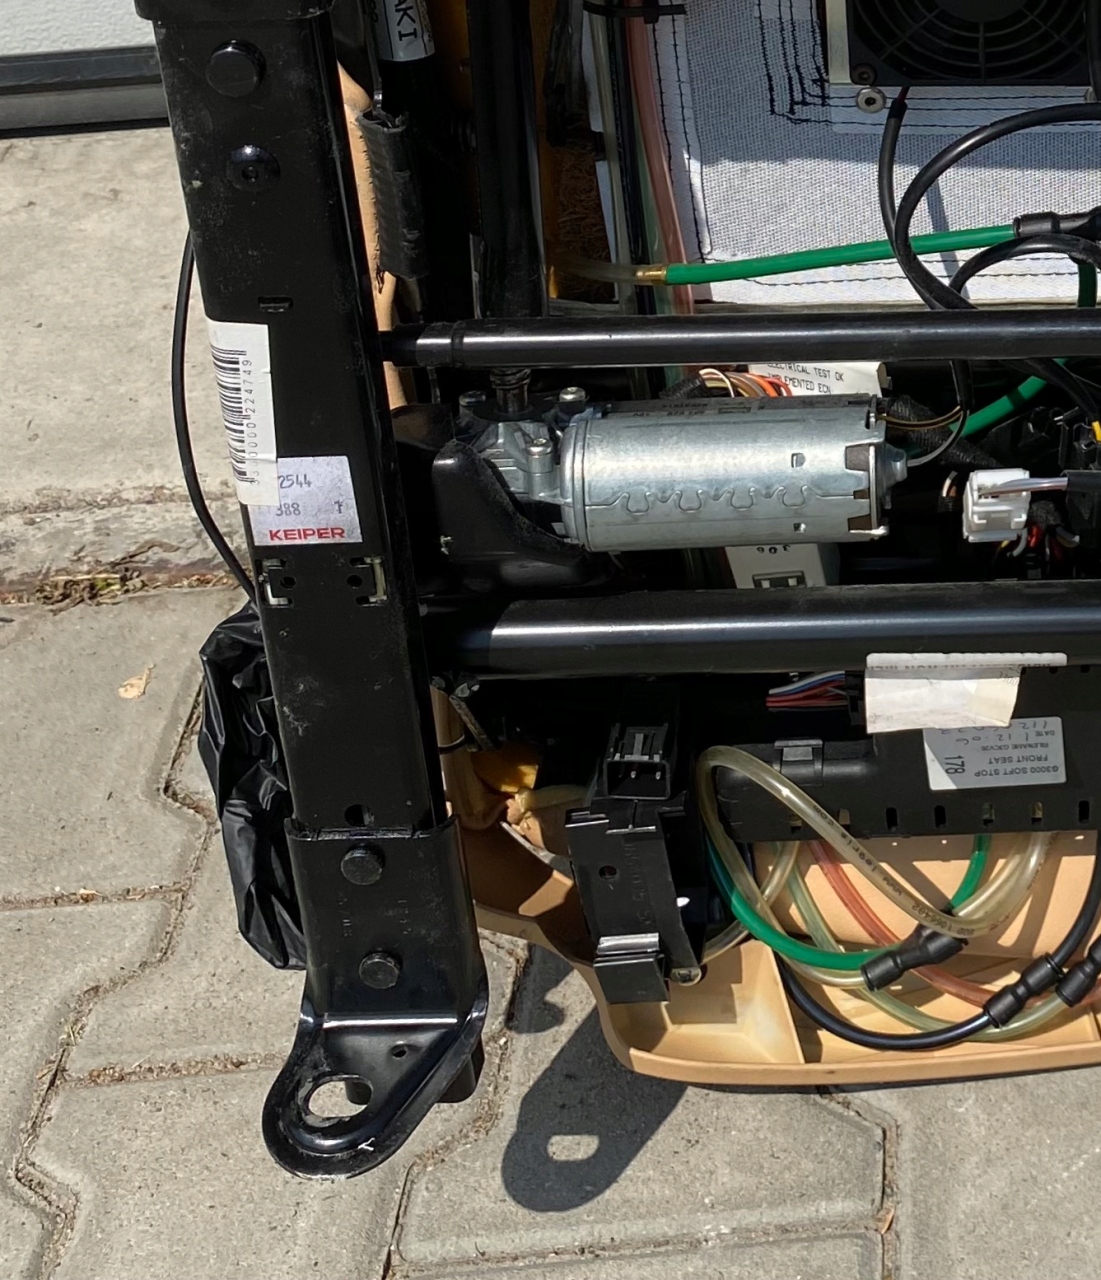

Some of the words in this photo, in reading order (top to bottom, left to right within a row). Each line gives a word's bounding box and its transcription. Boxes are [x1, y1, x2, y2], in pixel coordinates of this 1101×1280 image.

[813, 367, 831, 379] TEST
[834, 371, 845, 382] OK
[277, 473, 313, 489] 2544
[268, 527, 346, 542] KEIPER
[988, 755, 1014, 764] SEAT
[1016, 754, 1049, 763] FRONT
[943, 755, 966, 775] 178
[1030, 765, 1060, 774] G3000
[974, 768, 1001, 778] STOP
[1002, 766, 1028, 776] SOFT
